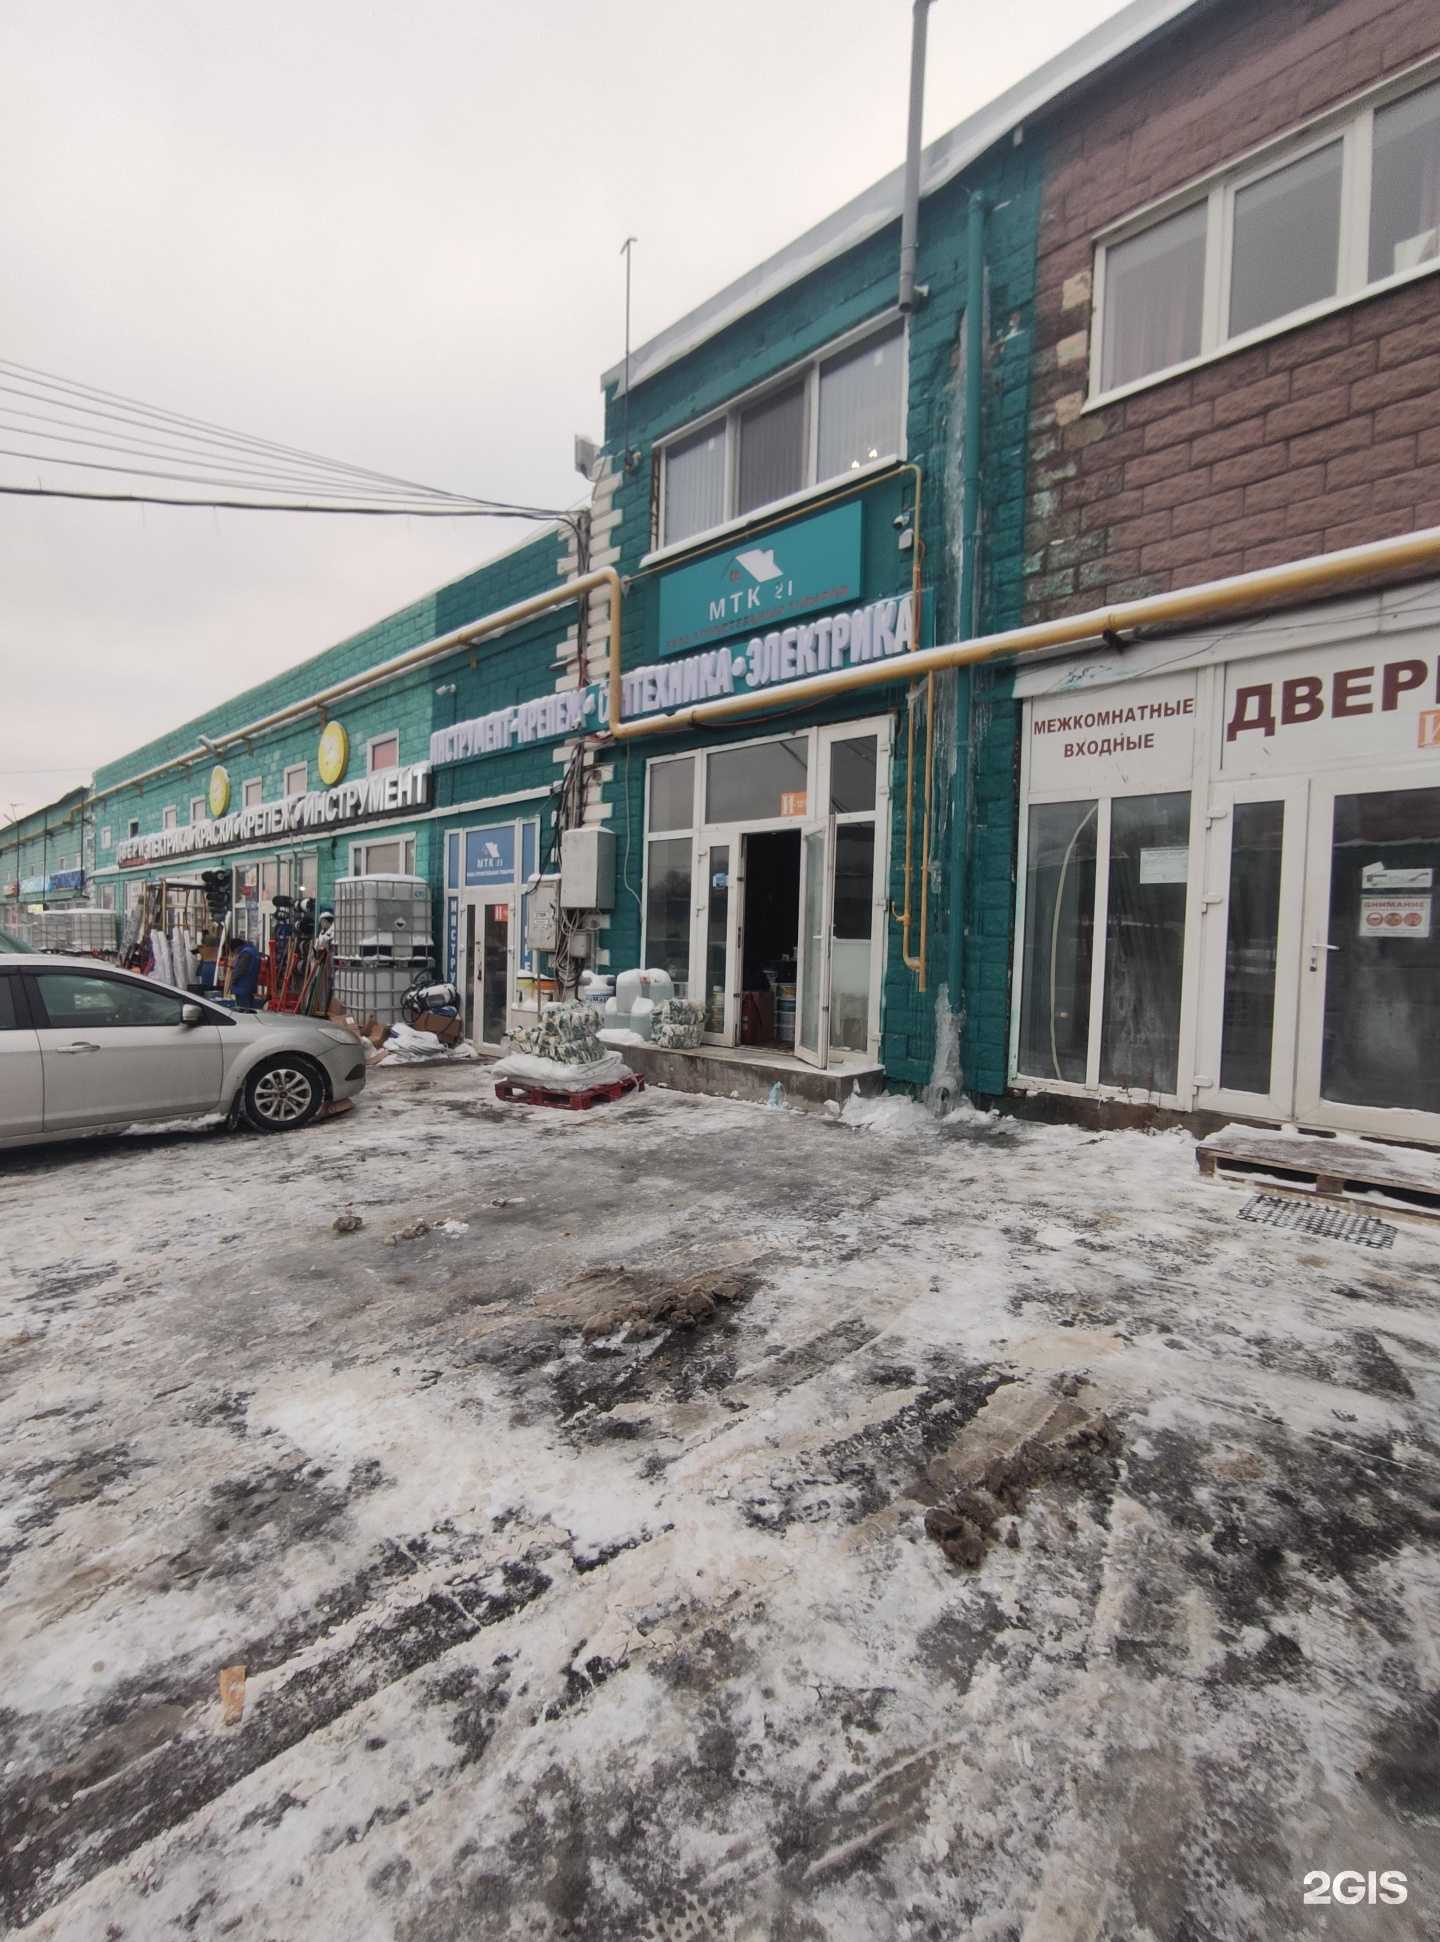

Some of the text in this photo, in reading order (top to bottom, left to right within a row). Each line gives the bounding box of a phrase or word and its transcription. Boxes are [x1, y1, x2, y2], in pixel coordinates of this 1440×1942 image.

[709, 585, 760, 621] МТК
[745, 592, 914, 687] ЭЛЕКТРИКА
[1033, 698, 1194, 735] МЕЖКОМНАТНЫЕ
[1226, 655, 1440, 742] ДВЕР
[1064, 733, 1155, 758] ВХОДНЫЕ
[240, 801, 297, 839] КРЕПЕЖ
[303, 766, 431, 826] ИНСТРУМЕНТ
